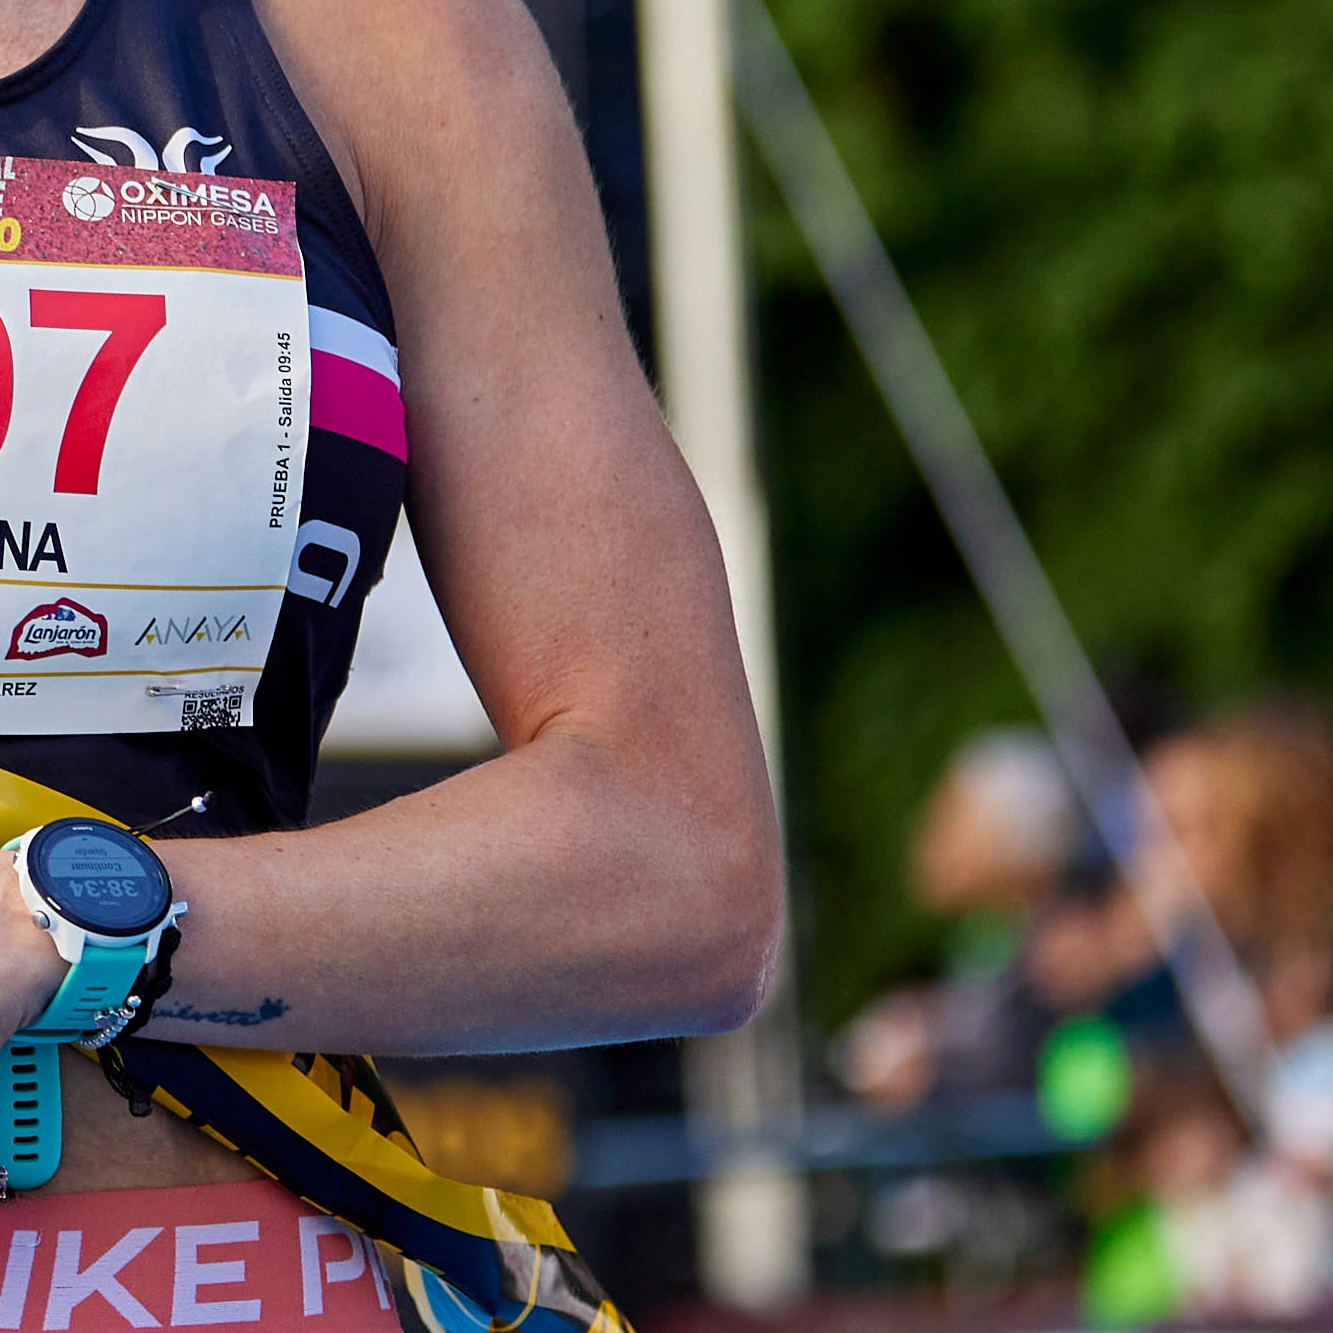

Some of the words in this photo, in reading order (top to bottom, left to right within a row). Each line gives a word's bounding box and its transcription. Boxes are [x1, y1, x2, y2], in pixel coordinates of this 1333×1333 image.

[120, 181, 276, 217] OXIMESA
[121, 209, 202, 226] NIPPON
[210, 211, 279, 235] GASES
[277, 332, 292, 374] 09:45
[277, 377, 293, 427] Salida
[277, 443, 290, 453] 1
[268, 457, 290, 529] PRUEBA
[24, 624, 96, 644] Lanjarón
[134, 615, 251, 645] ANAYA
